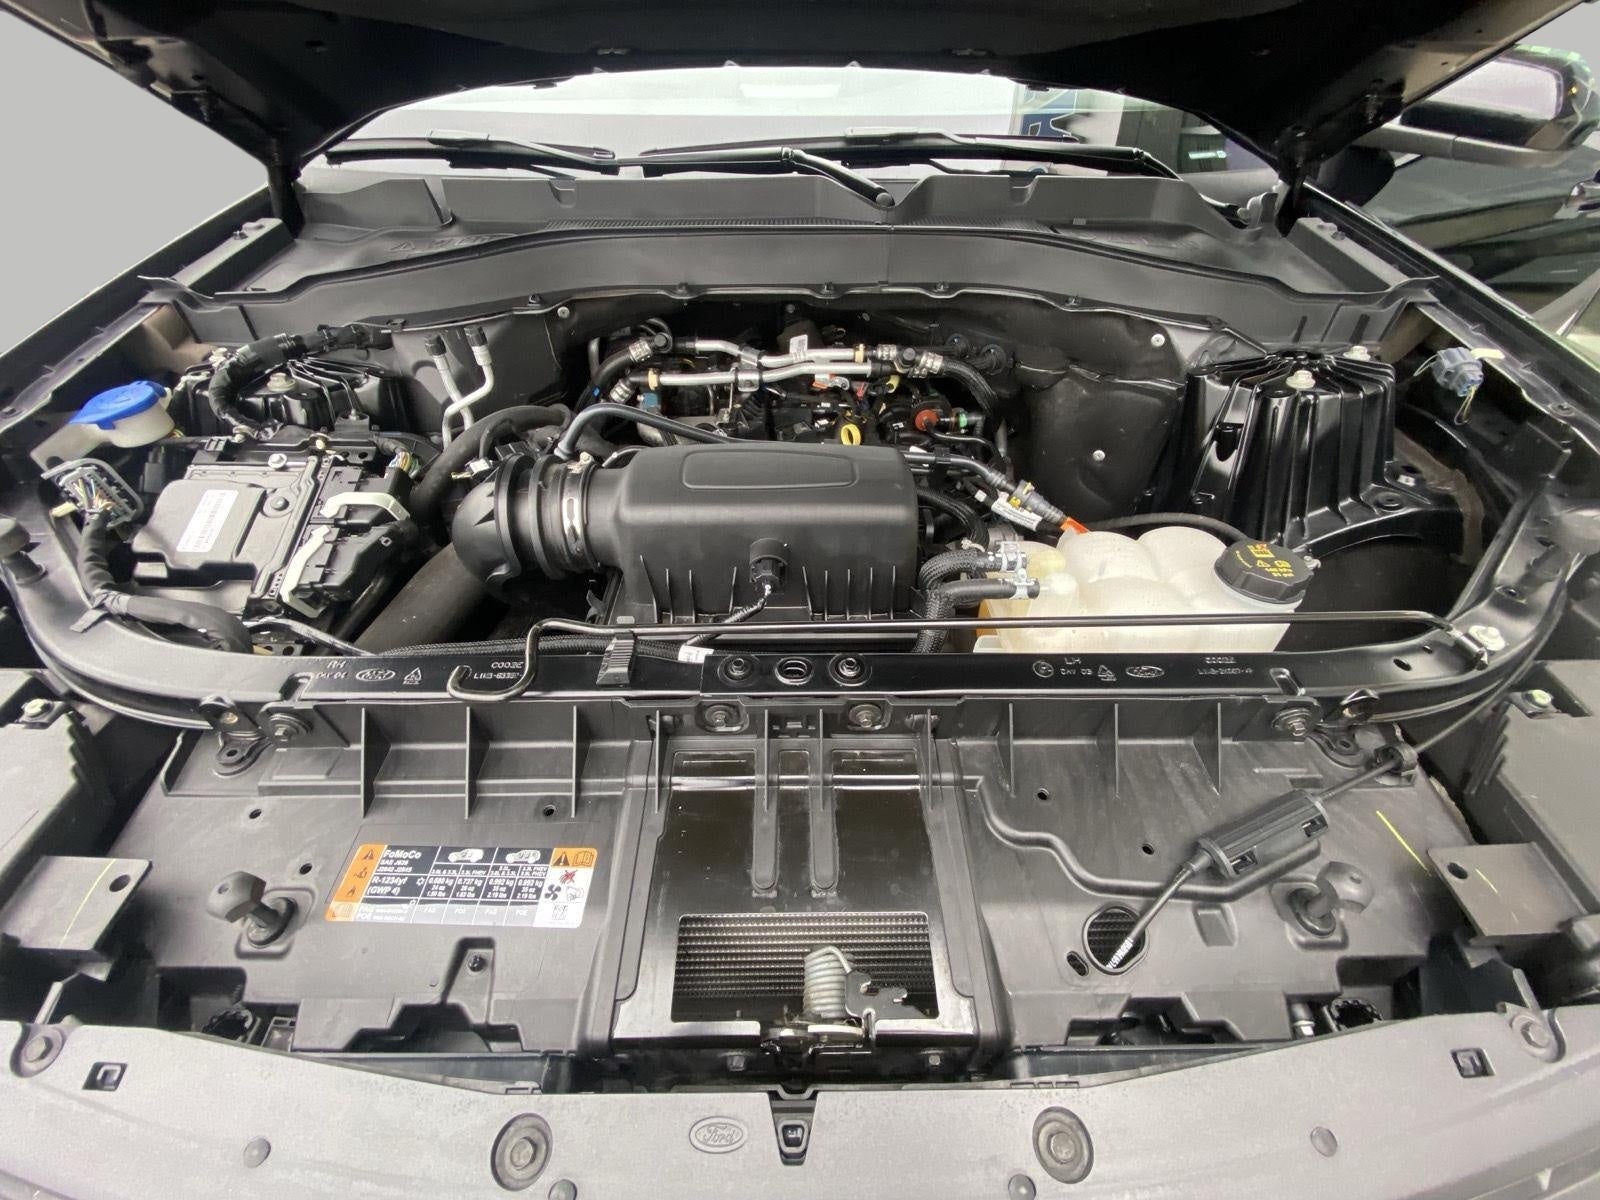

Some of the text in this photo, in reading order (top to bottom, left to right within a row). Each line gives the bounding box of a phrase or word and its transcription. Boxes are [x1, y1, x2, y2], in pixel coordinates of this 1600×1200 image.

[383, 849, 422, 859] FoMoCo
[371, 876, 409, 886] R-1234yf
[366, 886, 391, 895] (GWP
